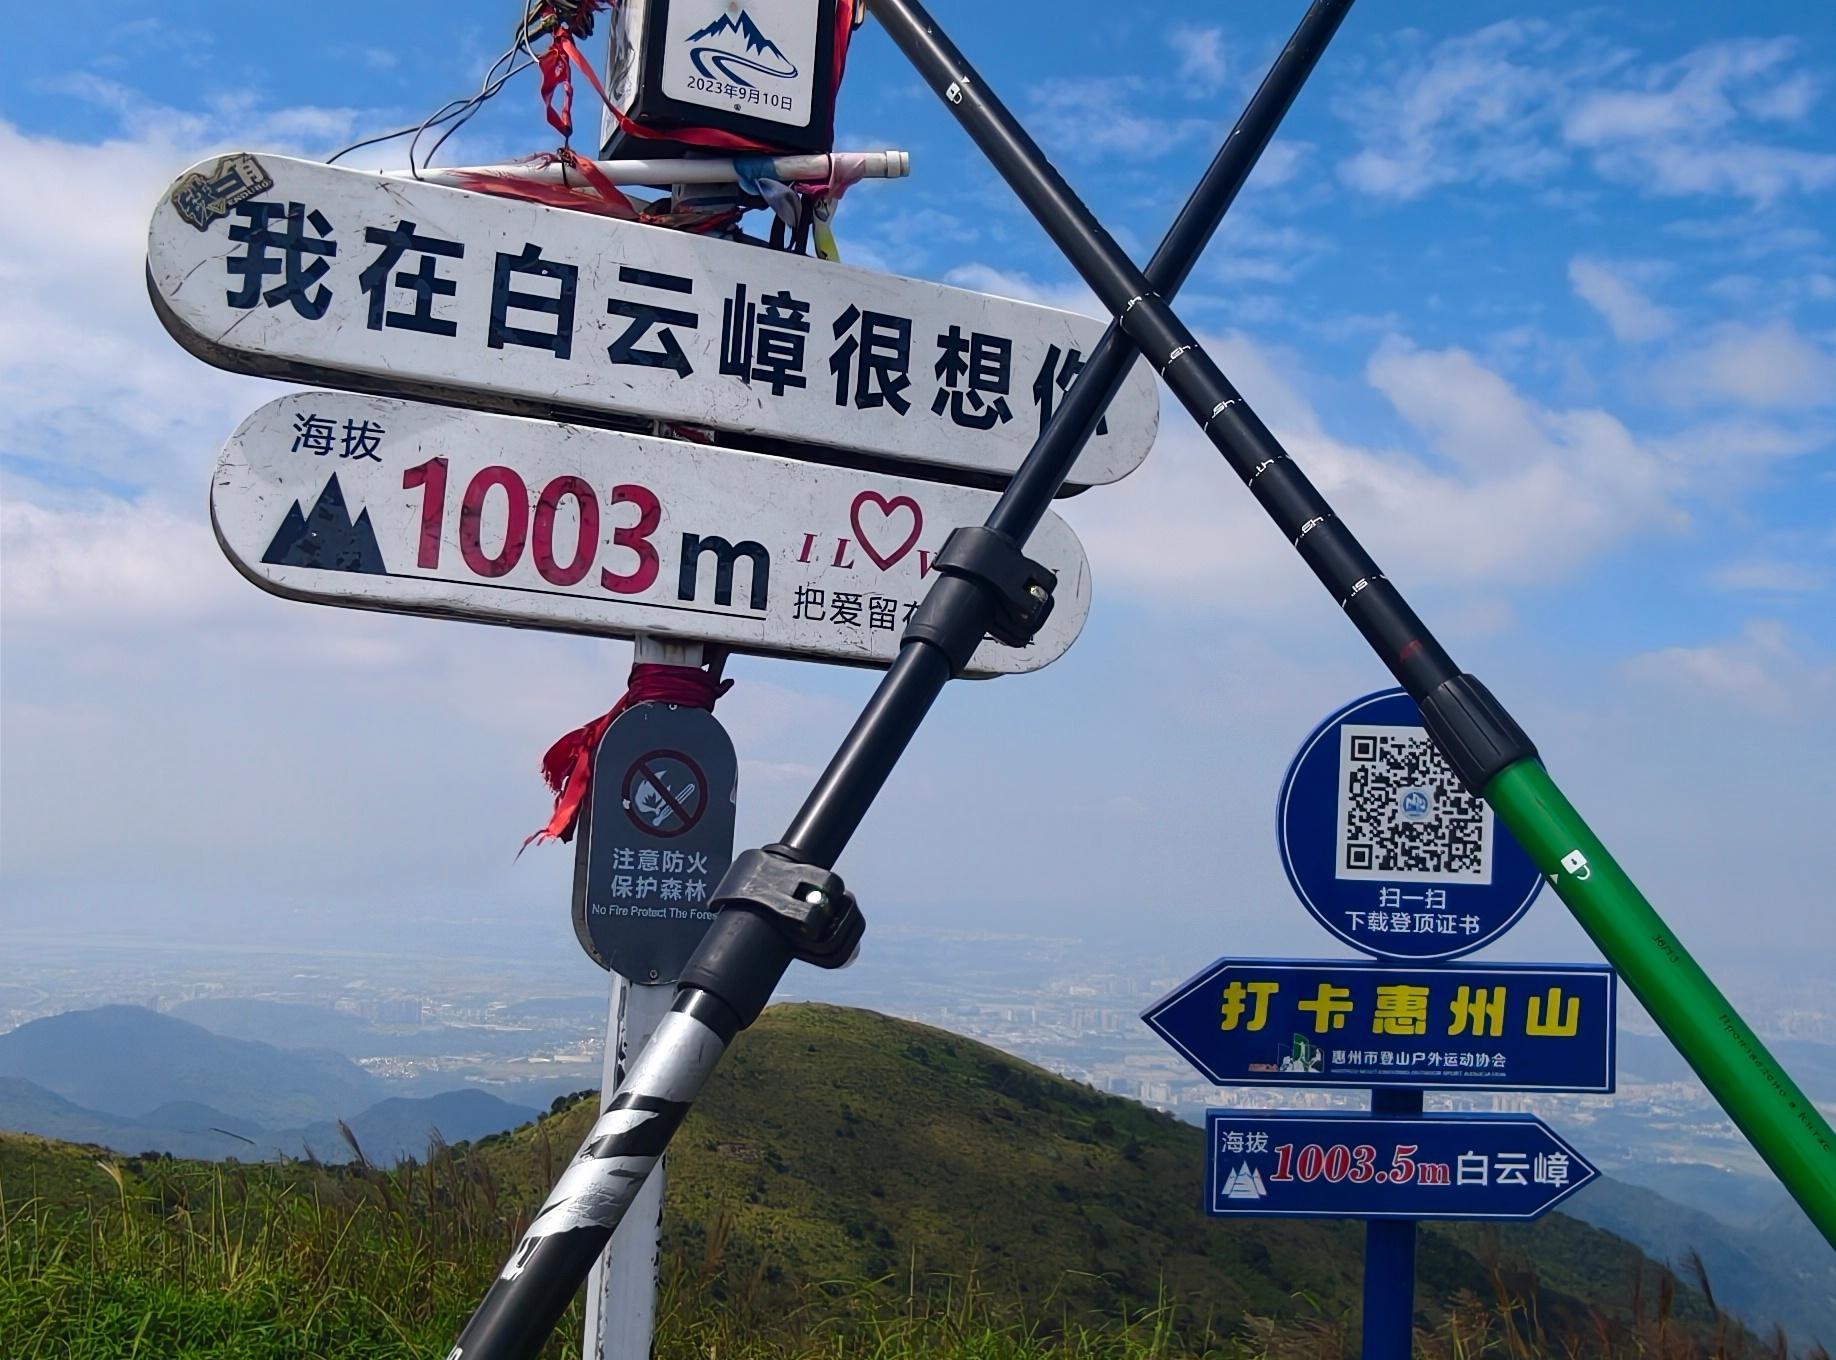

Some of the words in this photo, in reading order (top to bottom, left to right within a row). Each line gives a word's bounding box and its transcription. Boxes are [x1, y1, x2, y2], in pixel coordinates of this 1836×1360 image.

[687, 76, 793, 112] 2023年9月10日
[290, 413, 386, 464] 海拔
[797, 532, 818, 564] I
[612, 847, 708, 874] 注意防火
[611, 875, 707, 903] 保护森林
[1379, 886, 1446, 909] 扫一扫
[592, 904, 606, 915] No
[609, 905, 628, 915] Fire
[630, 906, 666, 917] Protect
[669, 908, 687, 919] The
[690, 909, 719, 920] Fores
[1345, 910, 1480, 935] 下载登顶证书
[1220, 981, 1581, 1037] 打卡惠州山
[1331, 1049, 1506, 1069] 惠州市登山户外运动协会
[1221, 1130, 1268, 1154] 海拔
[1456, 1150, 1570, 1188] 白云嶂
